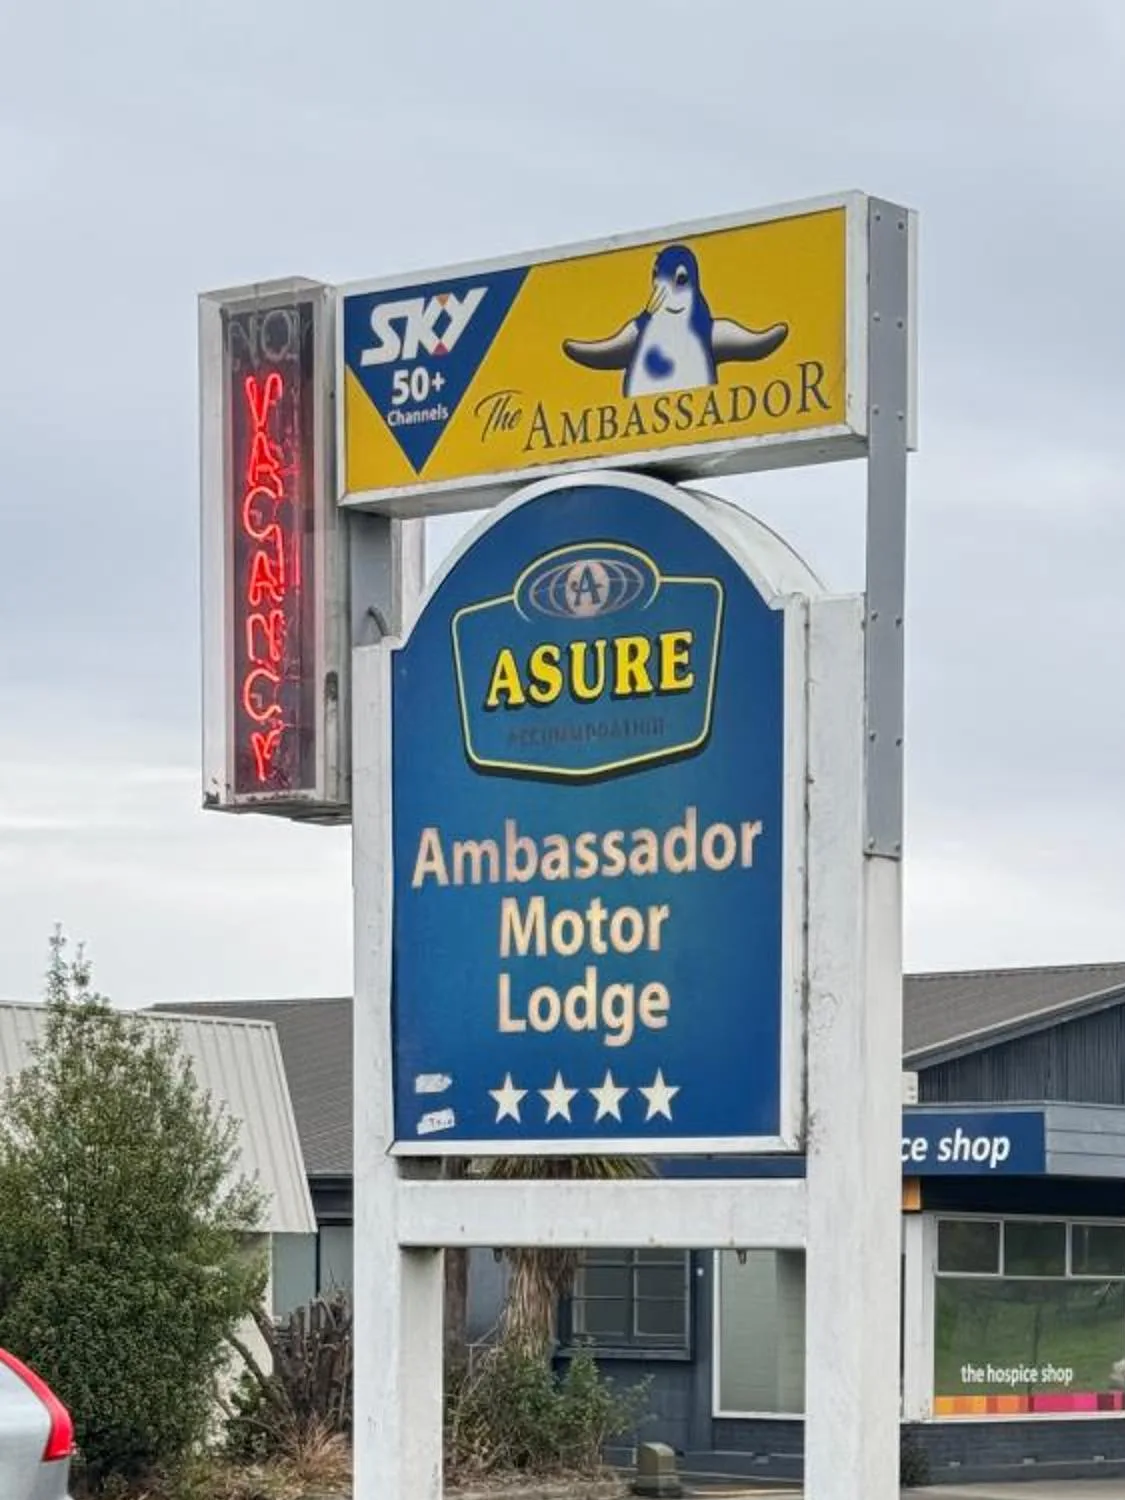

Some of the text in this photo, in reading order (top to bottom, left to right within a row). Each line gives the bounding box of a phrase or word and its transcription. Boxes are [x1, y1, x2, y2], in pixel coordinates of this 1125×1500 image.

[361, 287, 488, 366] SKY
[391, 366, 446, 404] 50+
[387, 404, 449, 427] Channels
[474, 388, 523, 442] The
[486, 630, 695, 707] ASURE
[411, 806, 762, 888] Ambassador
[500, 895, 670, 959] Motor
[499, 966, 671, 1047] Lodge
[937, 1128, 1011, 1169] shop
[960, 1364, 1073, 1387] the hospice shop
